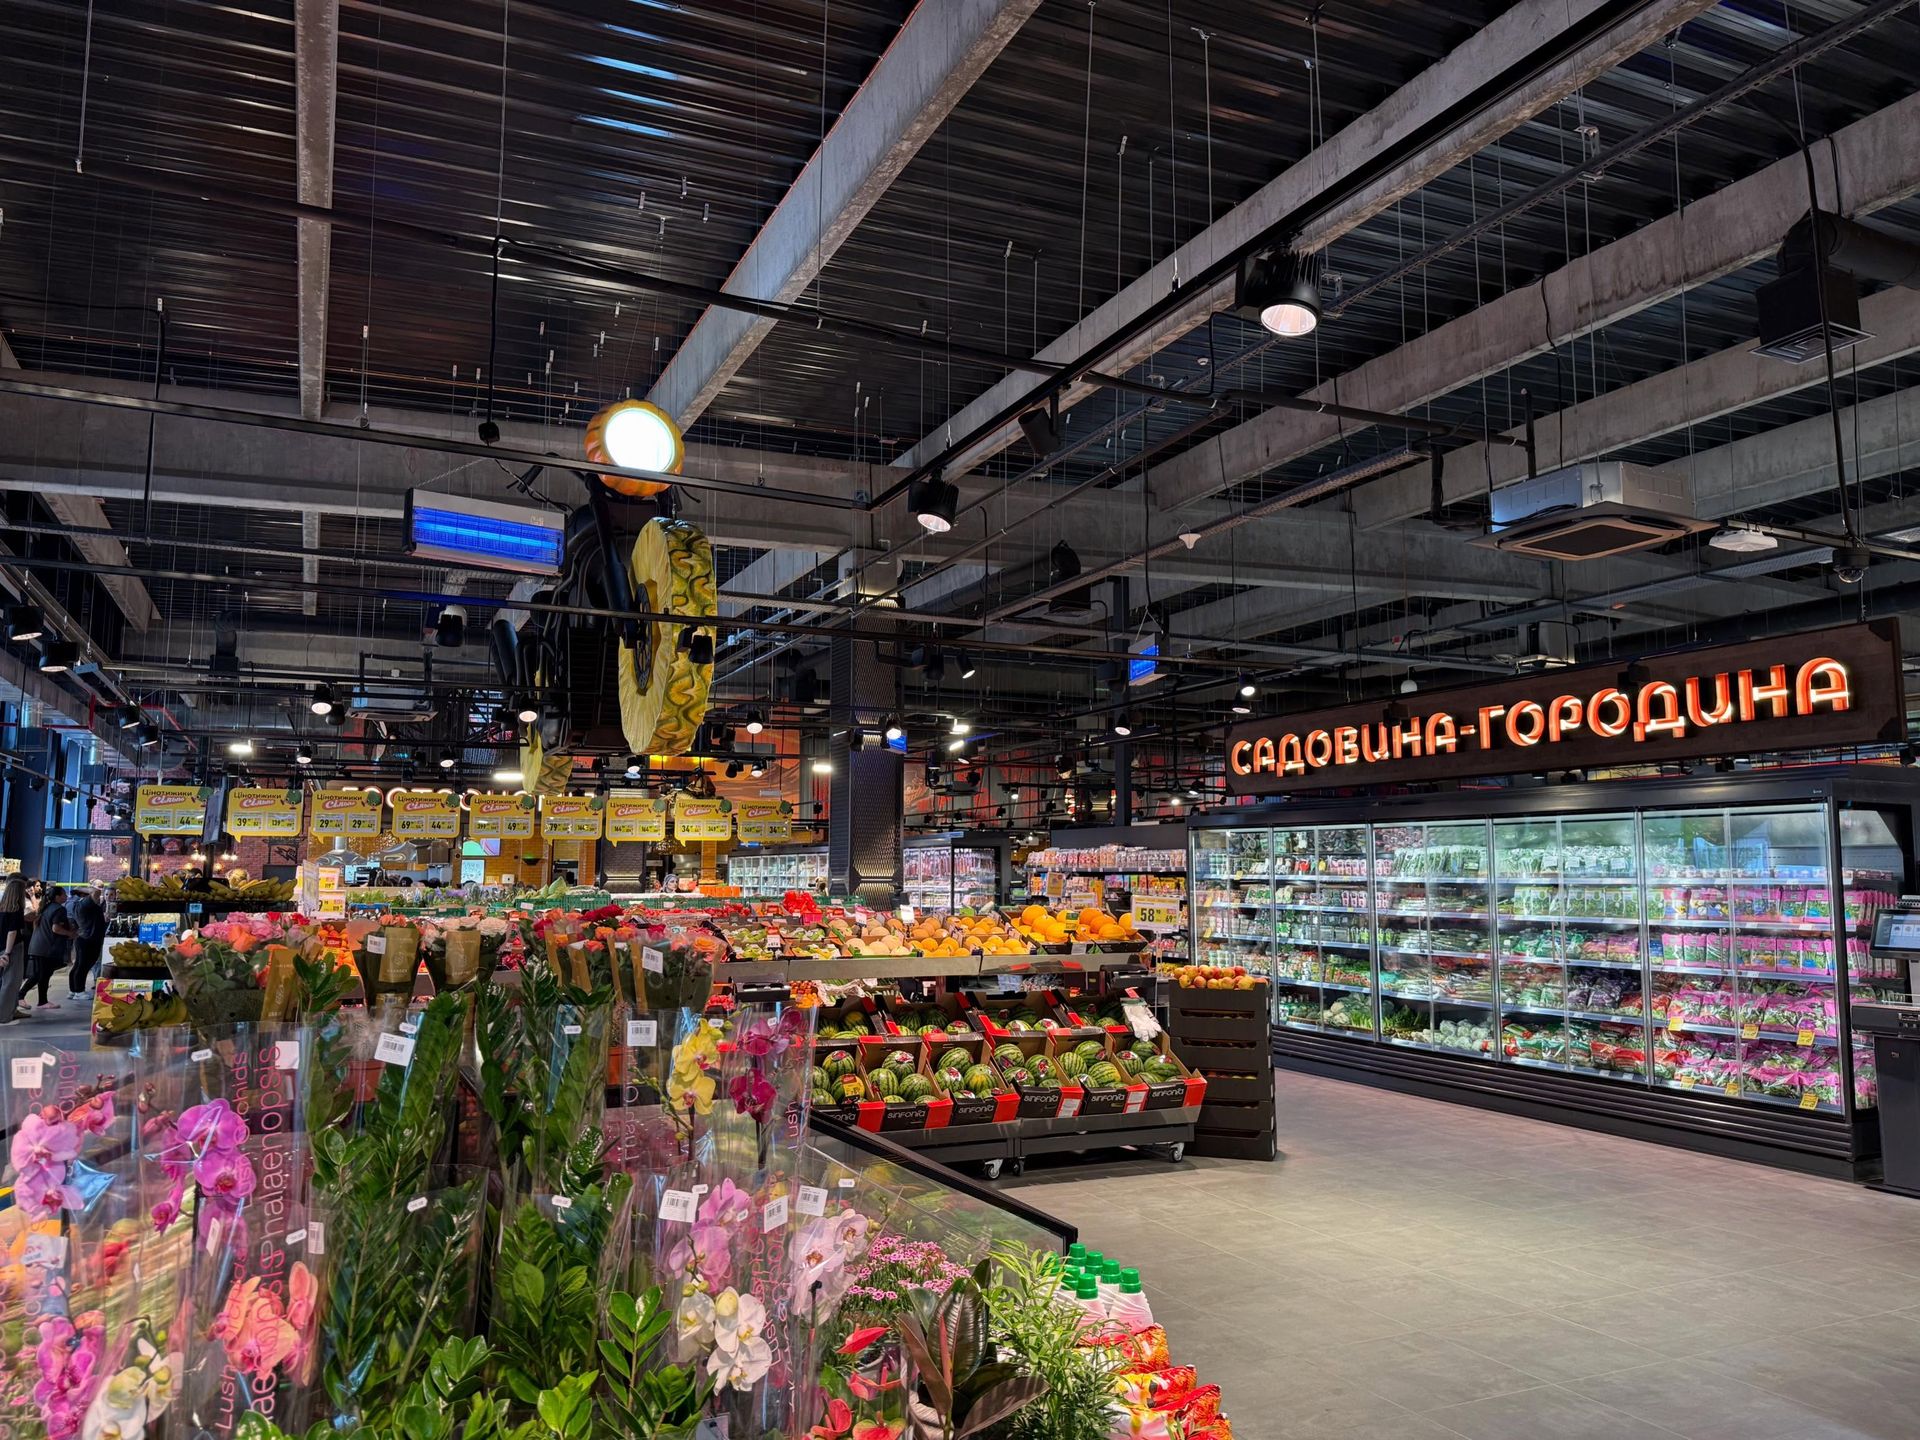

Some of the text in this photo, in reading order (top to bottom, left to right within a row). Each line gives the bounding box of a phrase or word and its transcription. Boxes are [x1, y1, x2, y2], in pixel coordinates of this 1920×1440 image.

[1231, 657, 1850, 777] САДОВИНА-ГОРОДИНА
[236, 817, 247, 827] 39
[319, 819, 329, 828] 29
[352, 819, 362, 829] 29
[401, 820, 411, 829] 69
[431, 820, 441, 829] 44
[507, 822, 517, 831] 49
[681, 824, 690, 833] 34
[1140, 907, 1155, 922] 58
[253, 1045, 290, 1263] Phalaenopsis
[215, 1363, 237, 1430] Lush
